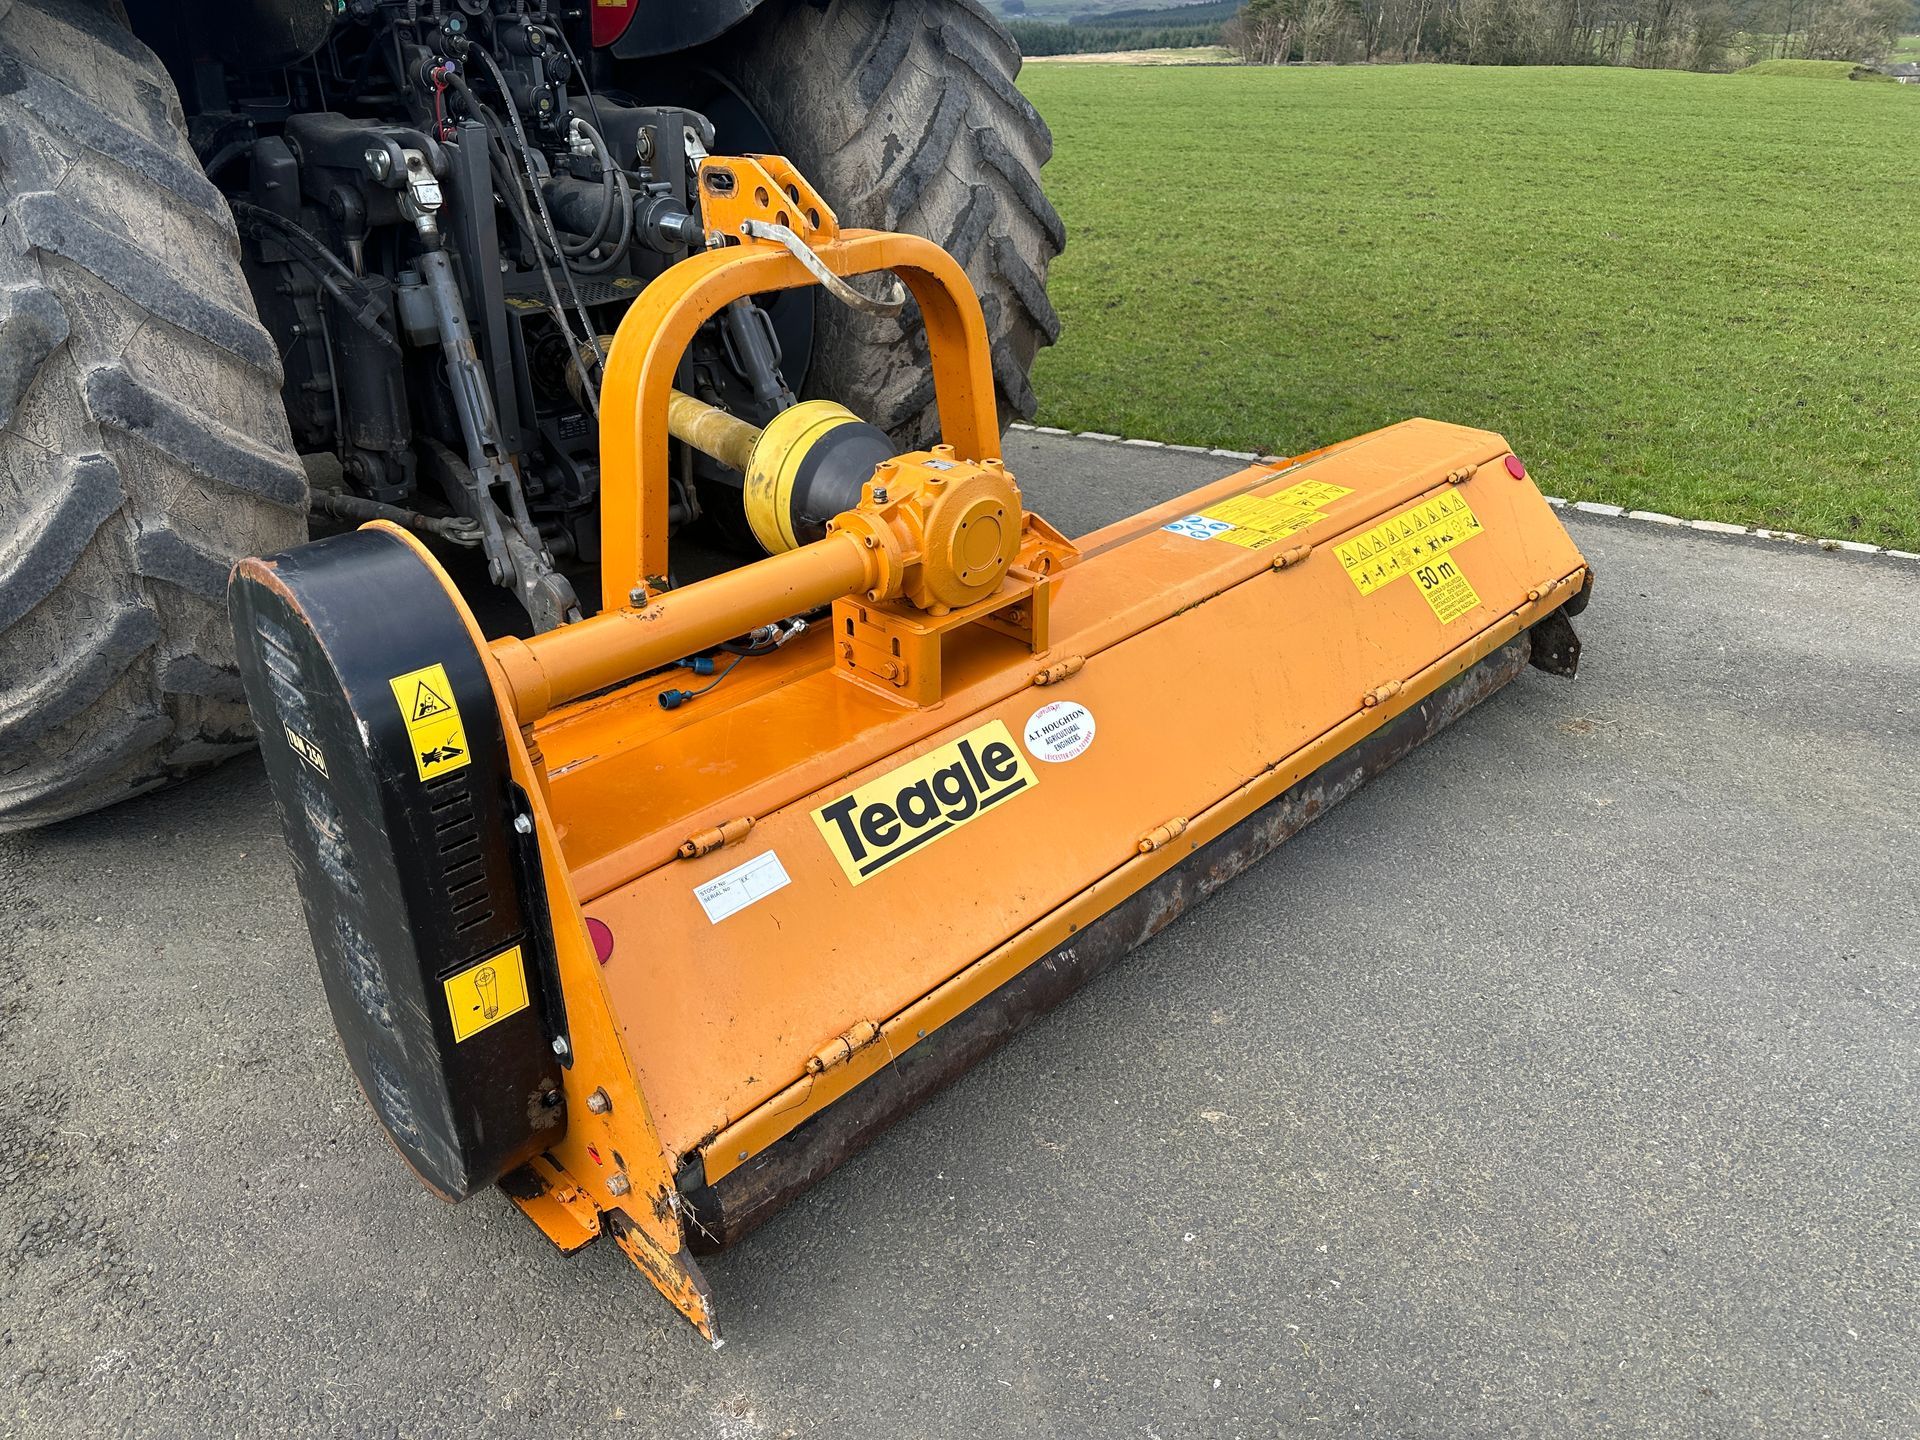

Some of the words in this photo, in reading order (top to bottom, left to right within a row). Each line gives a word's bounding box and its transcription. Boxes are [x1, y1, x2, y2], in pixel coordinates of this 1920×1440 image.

[1416, 566, 1439, 590] 50
[1437, 562, 1456, 580] m
[1029, 730, 1042, 742] A.T.
[1042, 709, 1084, 734] HOUGHTON
[1045, 723, 1080, 744] AGRICULTURAL
[1054, 734, 1081, 751] ENGINEERS
[306, 744, 326, 770] 250
[820, 739, 1018, 861] Teagle
[699, 885, 718, 896] STOCK
[703, 890, 722, 902] SERIAL
